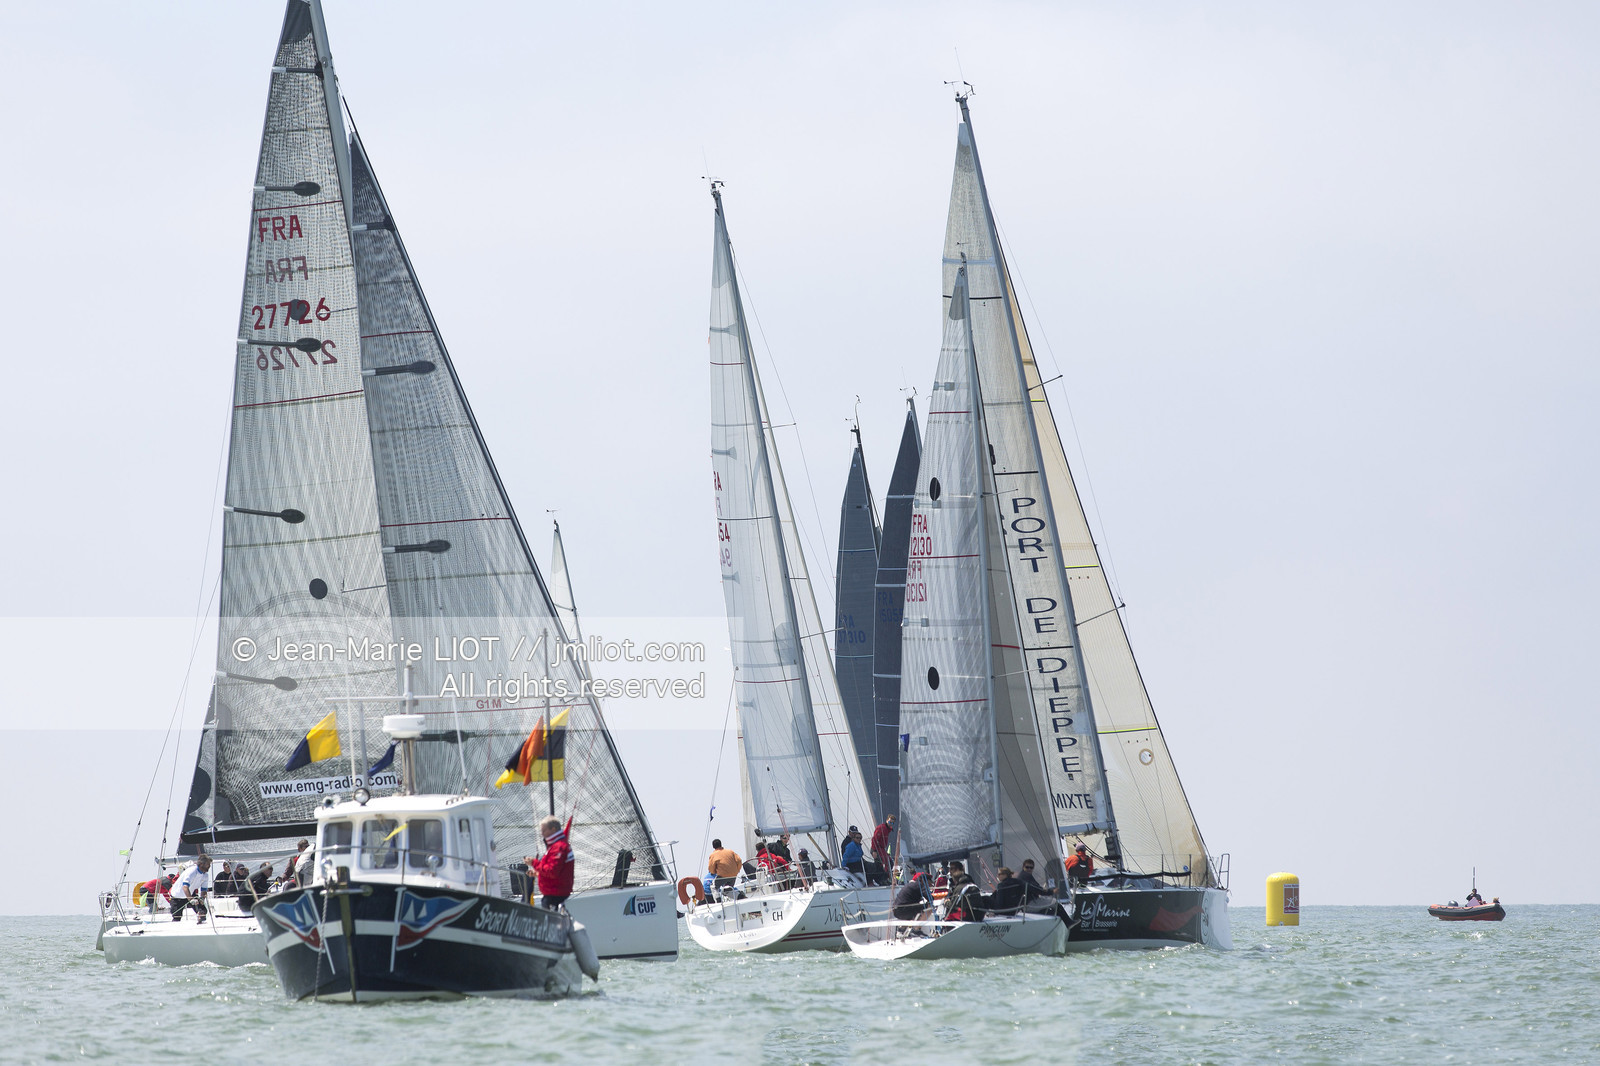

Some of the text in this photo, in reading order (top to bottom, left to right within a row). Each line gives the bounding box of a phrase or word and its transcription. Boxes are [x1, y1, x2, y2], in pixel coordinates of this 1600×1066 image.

[258, 215, 303, 243] FRA
[251, 297, 331, 330] 27726
[912, 514, 928, 533] FRA
[910, 536, 932, 556] 12130
[1010, 497, 1082, 773] PORT DE DIEPPE
[261, 773, 397, 795] www.emg-radiocom
[1050, 793, 1094, 810] MIXTE
[637, 901, 656, 914] CUP
[772, 911, 784, 922] CH
[1081, 901, 1131, 918] La Marine
